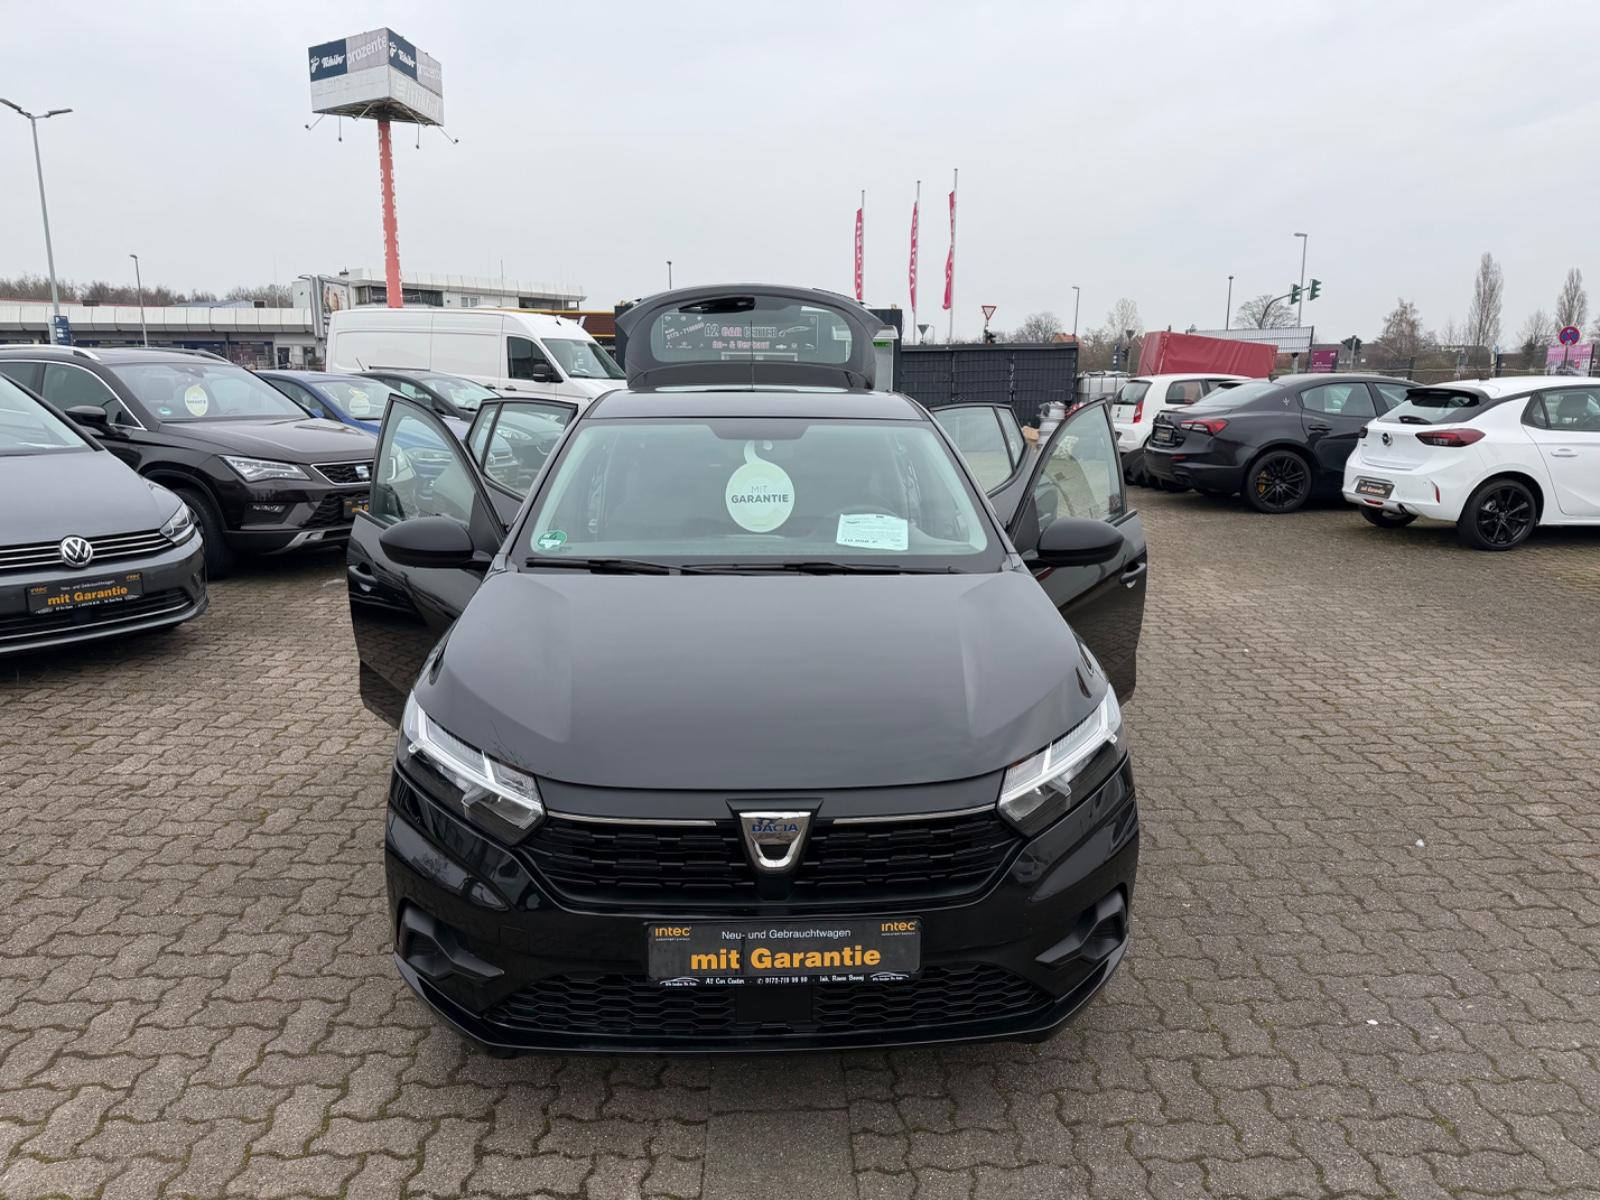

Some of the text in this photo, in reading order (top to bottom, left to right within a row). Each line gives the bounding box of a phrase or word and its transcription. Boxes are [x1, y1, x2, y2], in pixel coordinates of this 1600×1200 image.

[751, 485, 767, 493] MIT
[731, 493, 789, 504] GARANTIE
[47, 593, 70, 606] mit
[74, 585, 129, 602] Garantie
[751, 823, 799, 832] DACIA
[655, 926, 692, 937] intec
[881, 921, 917, 932] intec
[721, 928, 851, 940] Neu- und Gebrauchtwagen
[690, 945, 881, 970] mit Garantie
